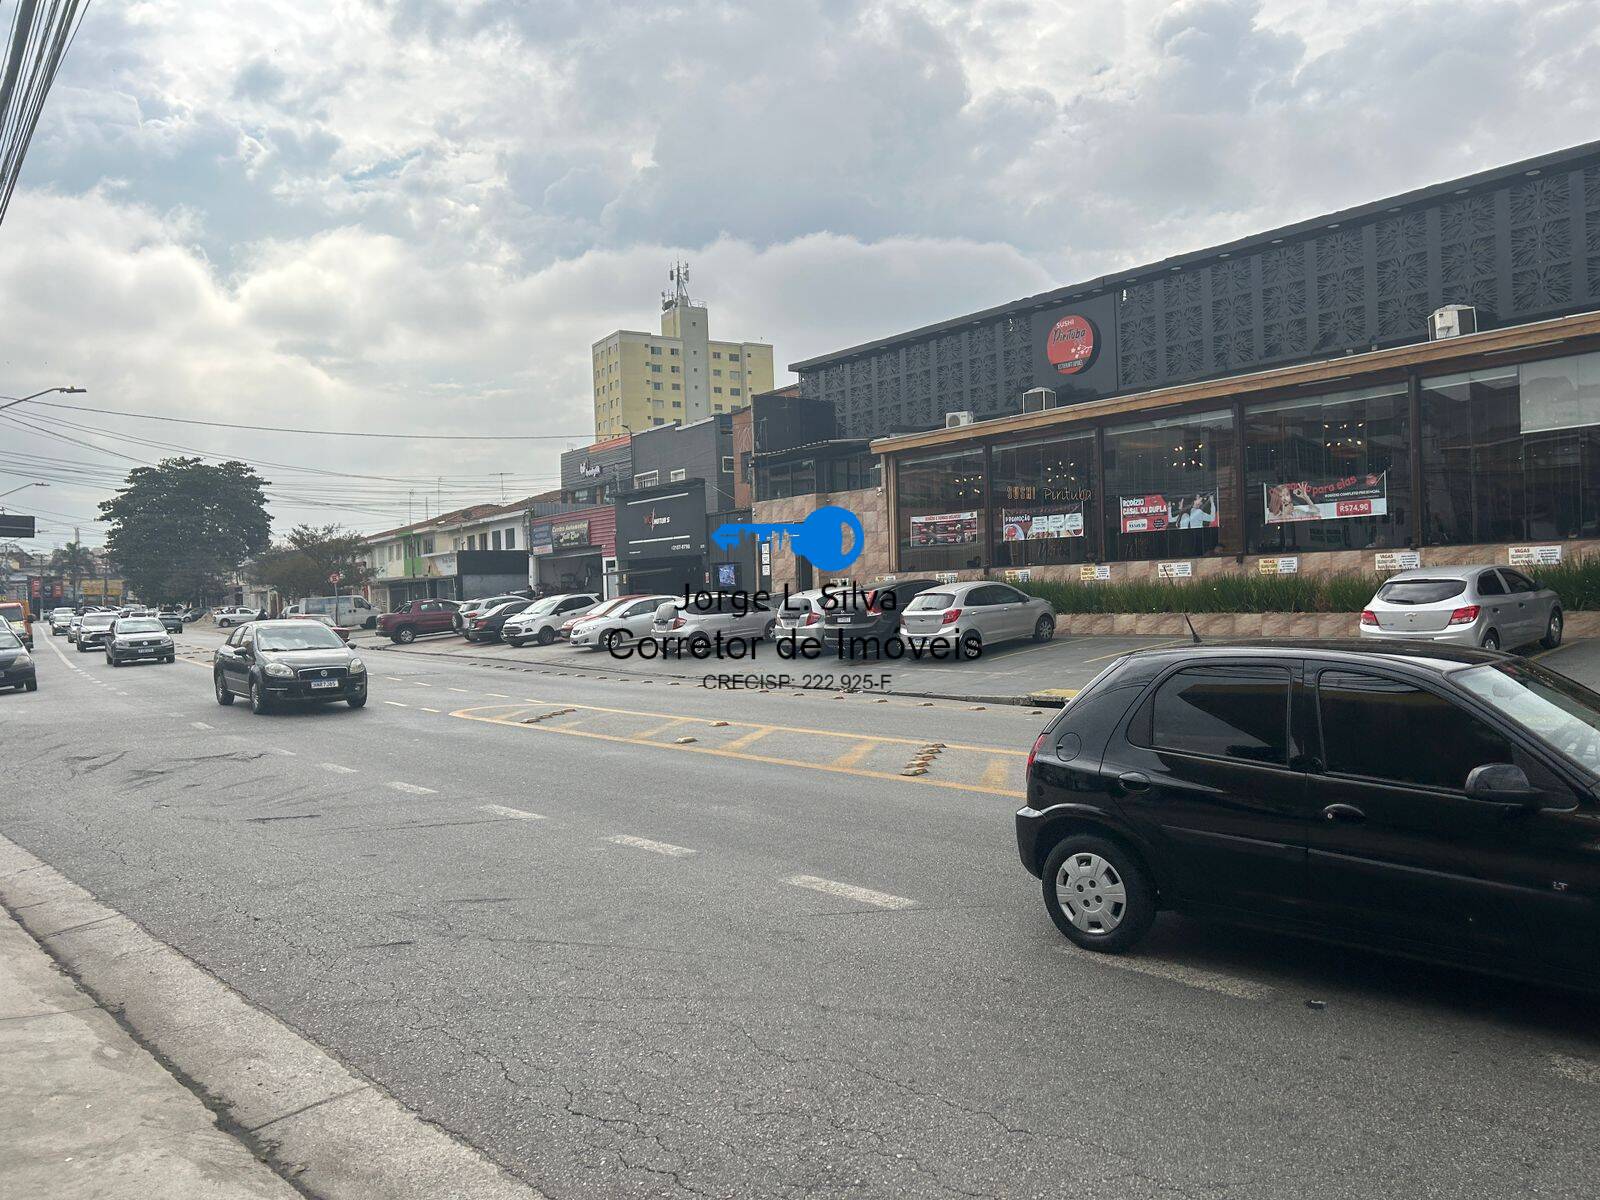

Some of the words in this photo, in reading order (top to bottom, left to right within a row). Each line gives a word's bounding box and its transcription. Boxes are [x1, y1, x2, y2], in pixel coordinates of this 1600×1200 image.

[1312, 484, 1335, 497] para
[1336, 475, 1358, 490] elas
[1006, 485, 1036, 501] SUSHI
[1122, 498, 1145, 507] RODÍZIO
[1339, 503, 1369, 513] R$74,90
[1122, 506, 1140, 515] CASAL
[1140, 506, 1148, 514] OU
[1148, 504, 1168, 514] DUPLA
